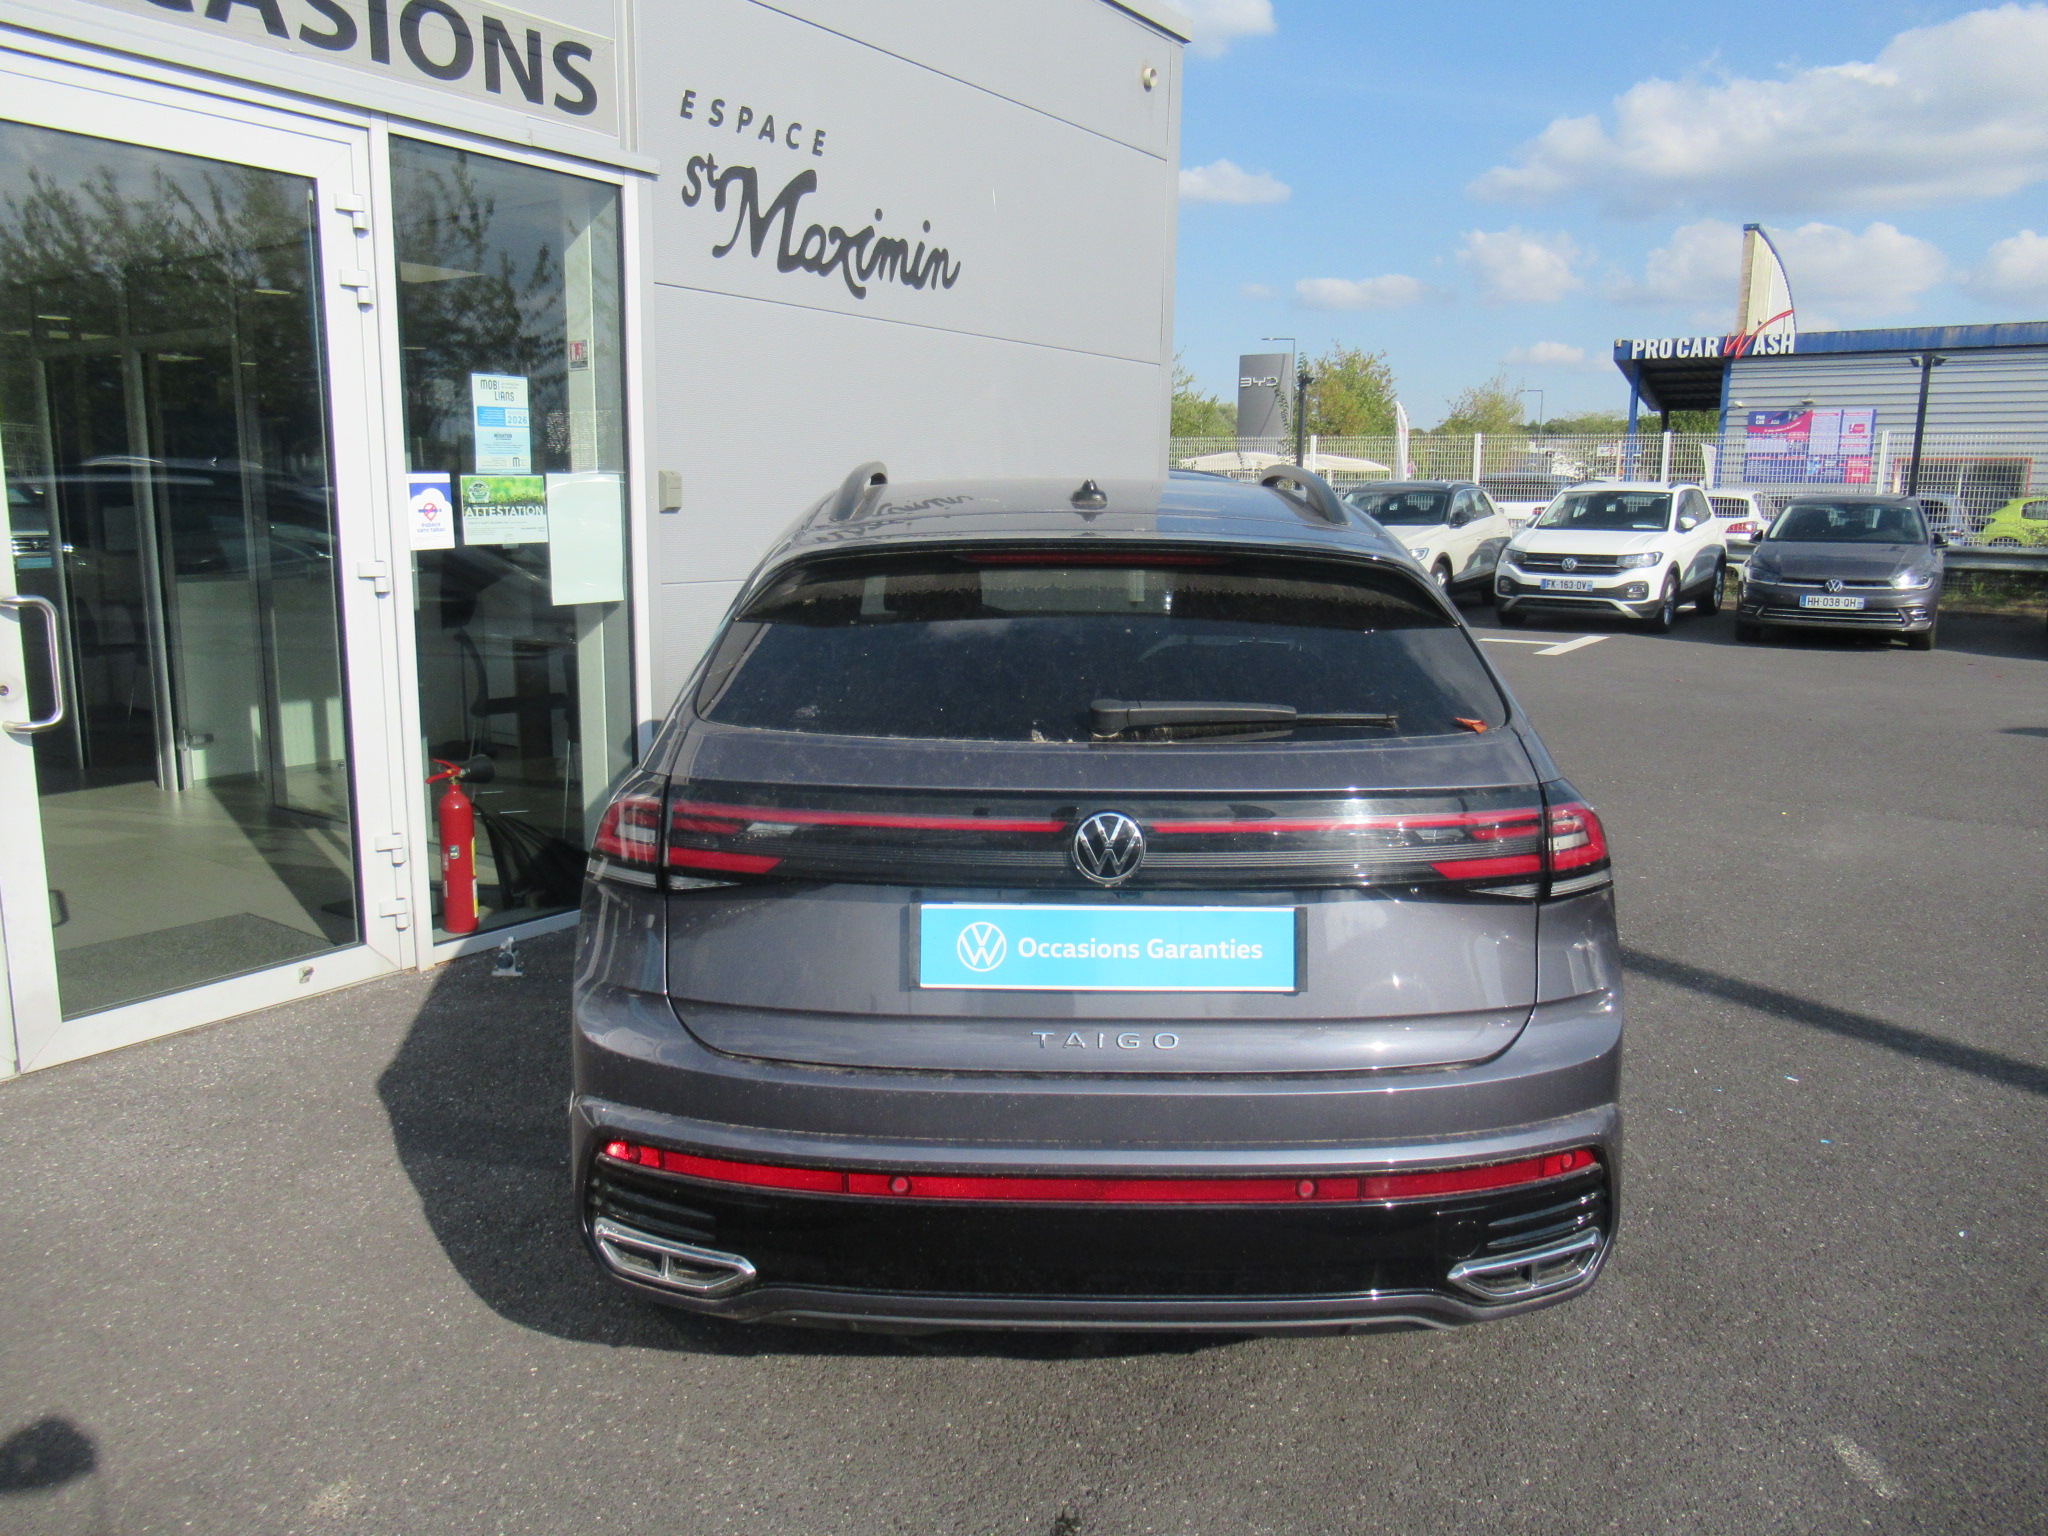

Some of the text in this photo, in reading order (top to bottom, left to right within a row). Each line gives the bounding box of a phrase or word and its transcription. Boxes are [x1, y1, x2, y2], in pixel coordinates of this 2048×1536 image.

[145, 0, 598, 116] SIONS
[680, 89, 827, 156] ESPACE
[712, 165, 961, 299] Maximin
[1631, 322, 1795, 359] PRO CAR WASH
[1240, 376, 1278, 387] BYD
[465, 505, 544, 517] ATTESTATION
[1017, 937, 1140, 960] Occasions
[1146, 937, 1263, 960] Garanties
[1031, 1031, 1180, 1050] TAIGO
